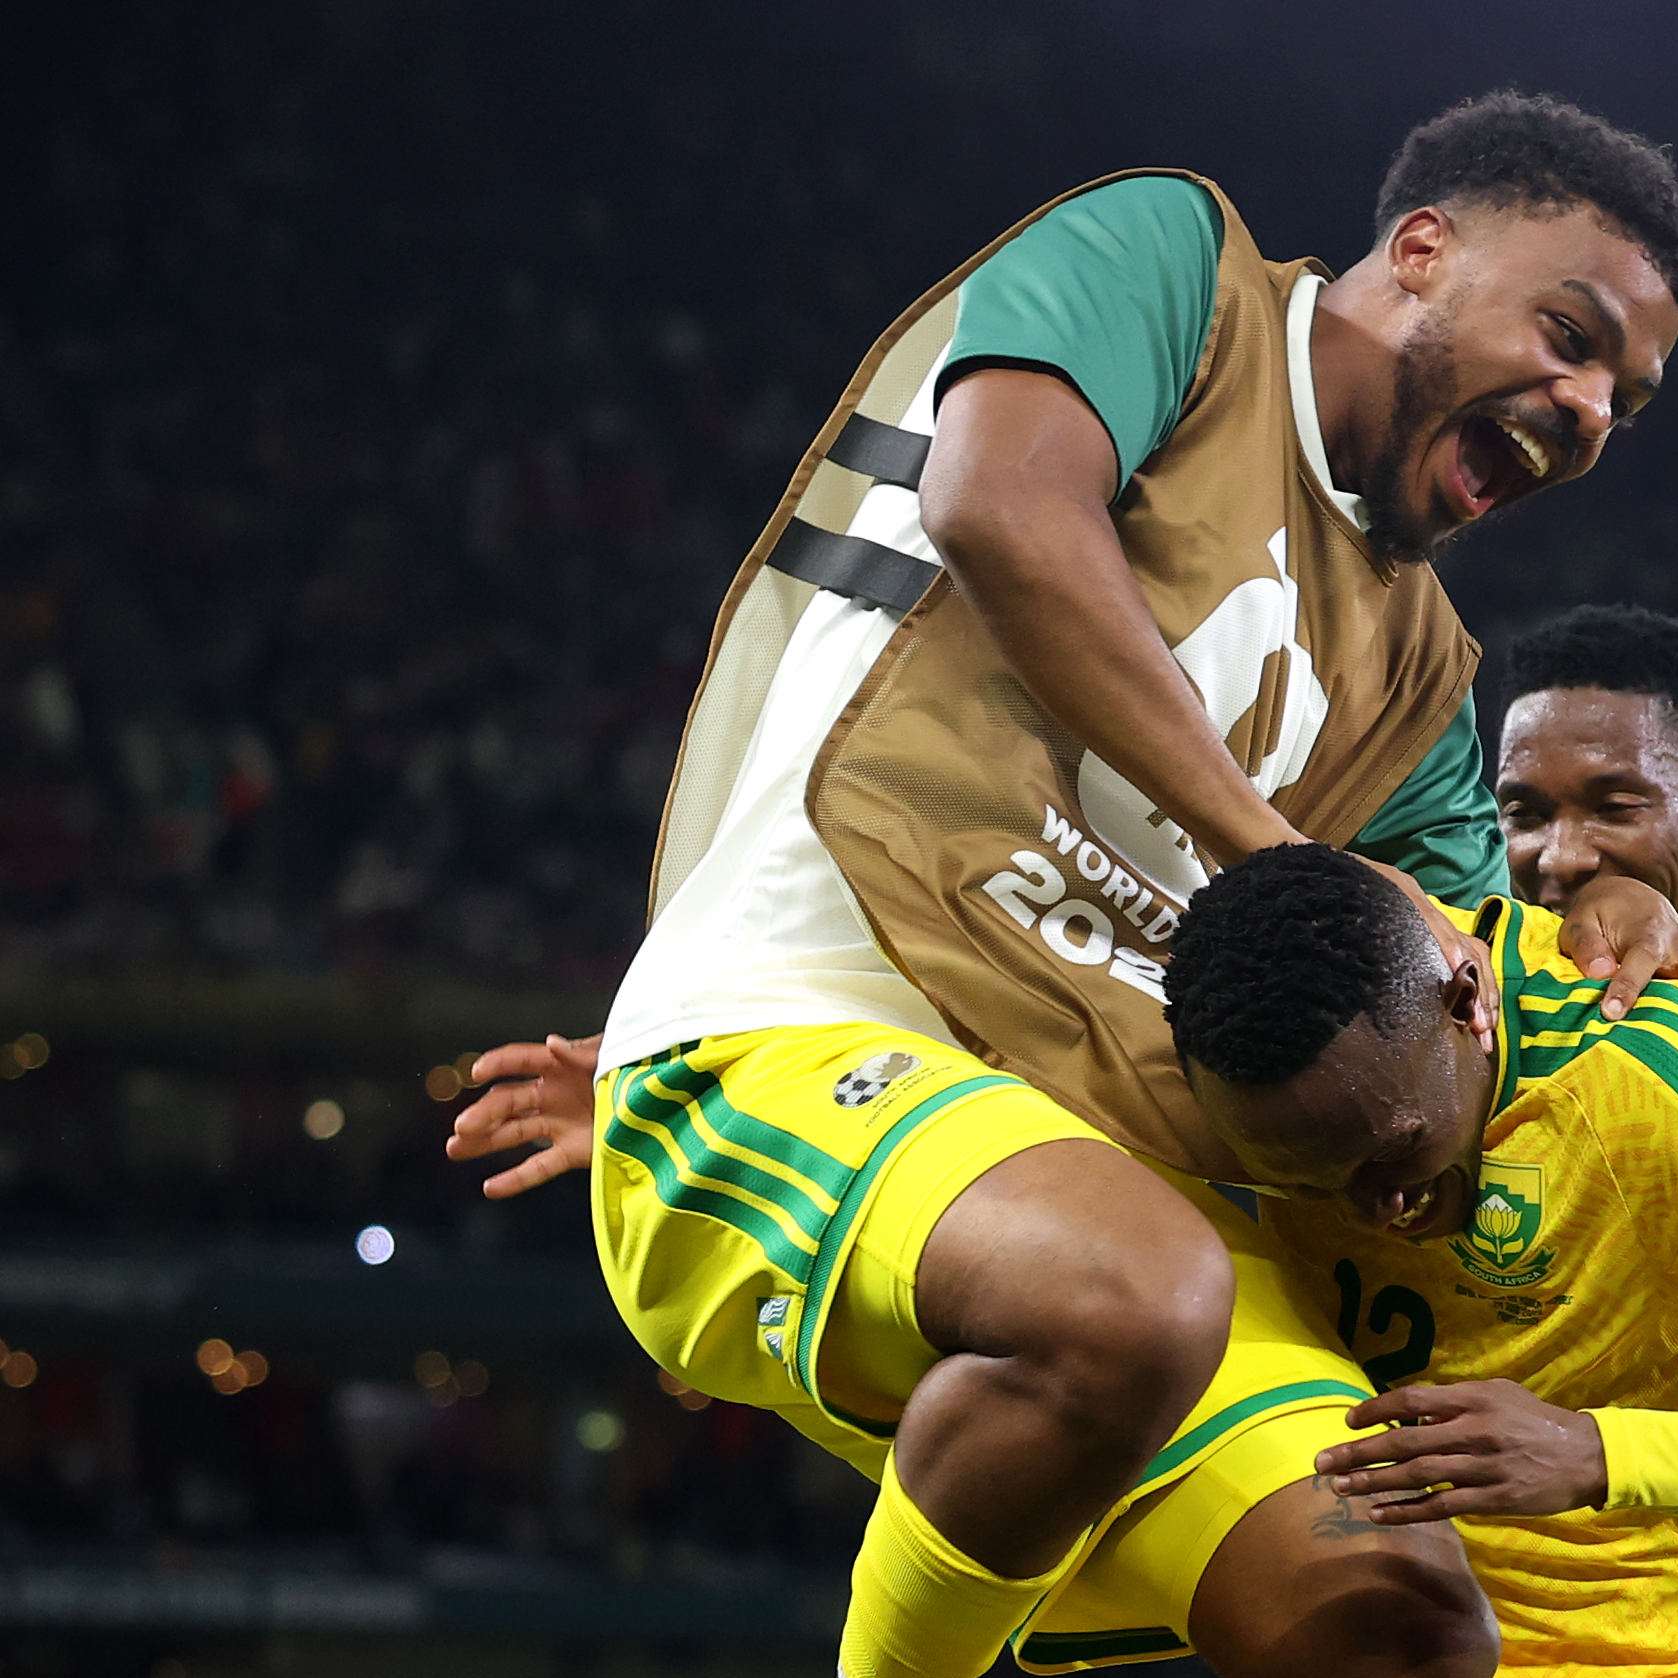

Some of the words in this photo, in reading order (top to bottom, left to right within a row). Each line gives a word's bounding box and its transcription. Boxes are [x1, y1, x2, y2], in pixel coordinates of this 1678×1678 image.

[1041, 804, 1181, 943] WORLD
[1468, 1264, 1502, 1284] SOUTH
[1505, 1270, 1541, 1285] AFRICA
